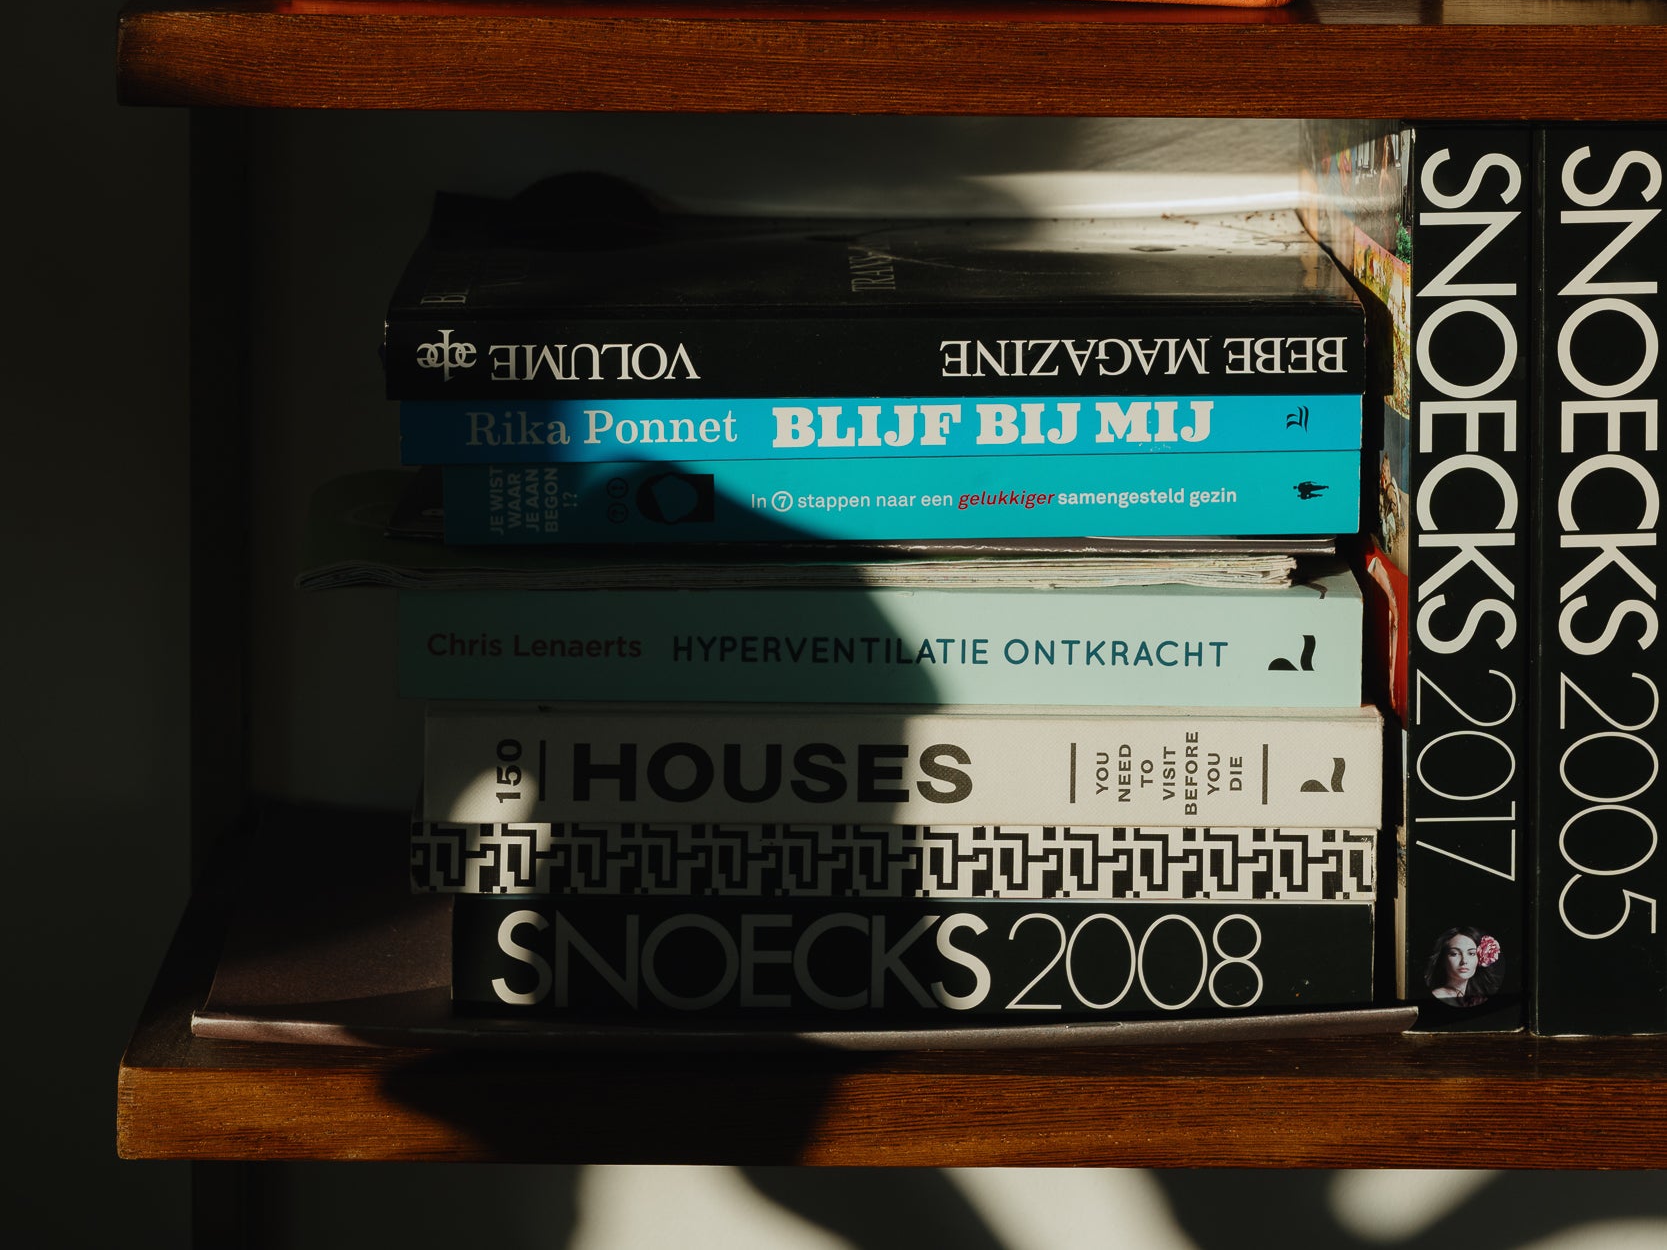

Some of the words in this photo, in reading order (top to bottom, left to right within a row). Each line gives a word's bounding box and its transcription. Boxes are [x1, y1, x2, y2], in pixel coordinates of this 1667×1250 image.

[488, 342, 701, 381] VOLUME
[939, 338, 1209, 377] MAGAZINE
[1223, 336, 1348, 375] BEBE
[772, 403, 961, 448] BLIJF
[976, 402, 1081, 446] BIJ
[1094, 400, 1215, 444] MIJ
[1416, 148, 1522, 654] SNOECKS
[1557, 146, 1663, 655] SNOECKS
[465, 410, 570, 446] Rika
[582, 409, 738, 444] Ponnet
[489, 465, 504, 512] WIST
[507, 473, 522, 529] WAAR
[525, 468, 540, 509] AAN
[544, 468, 559, 533] BEGON
[751, 493, 767, 509] In
[797, 493, 869, 513] stappen
[876, 495, 916, 508] naar
[921, 494, 954, 507] een
[958, 490, 1055, 511] gelukkiger
[1058, 488, 1184, 510] samengesteld
[1190, 489, 1237, 509] gezin
[490, 515, 504, 535] JE
[526, 513, 540, 533] JE
[428, 633, 503, 658] Chris
[513, 635, 642, 658] Lenaerts
[673, 636, 989, 665] HYPERVENTILATIE
[1004, 639, 1228, 667] ONTKRACHT
[496, 738, 523, 803] 150
[572, 742, 973, 804] HOUSES
[1096, 751, 1110, 795] YOU
[1118, 743, 1132, 802] NEED
[1140, 758, 1154, 788] TO
[1163, 746, 1176, 801] VISIT
[1185, 731, 1198, 815] BEFORE
[1207, 751, 1221, 795] YOU
[1230, 755, 1243, 791] DIE
[1416, 668, 1516, 881] 2017
[1559, 671, 1659, 940] 2005
[491, 910, 992, 1011] SNOECKS
[1005, 913, 1264, 1010] 2008
